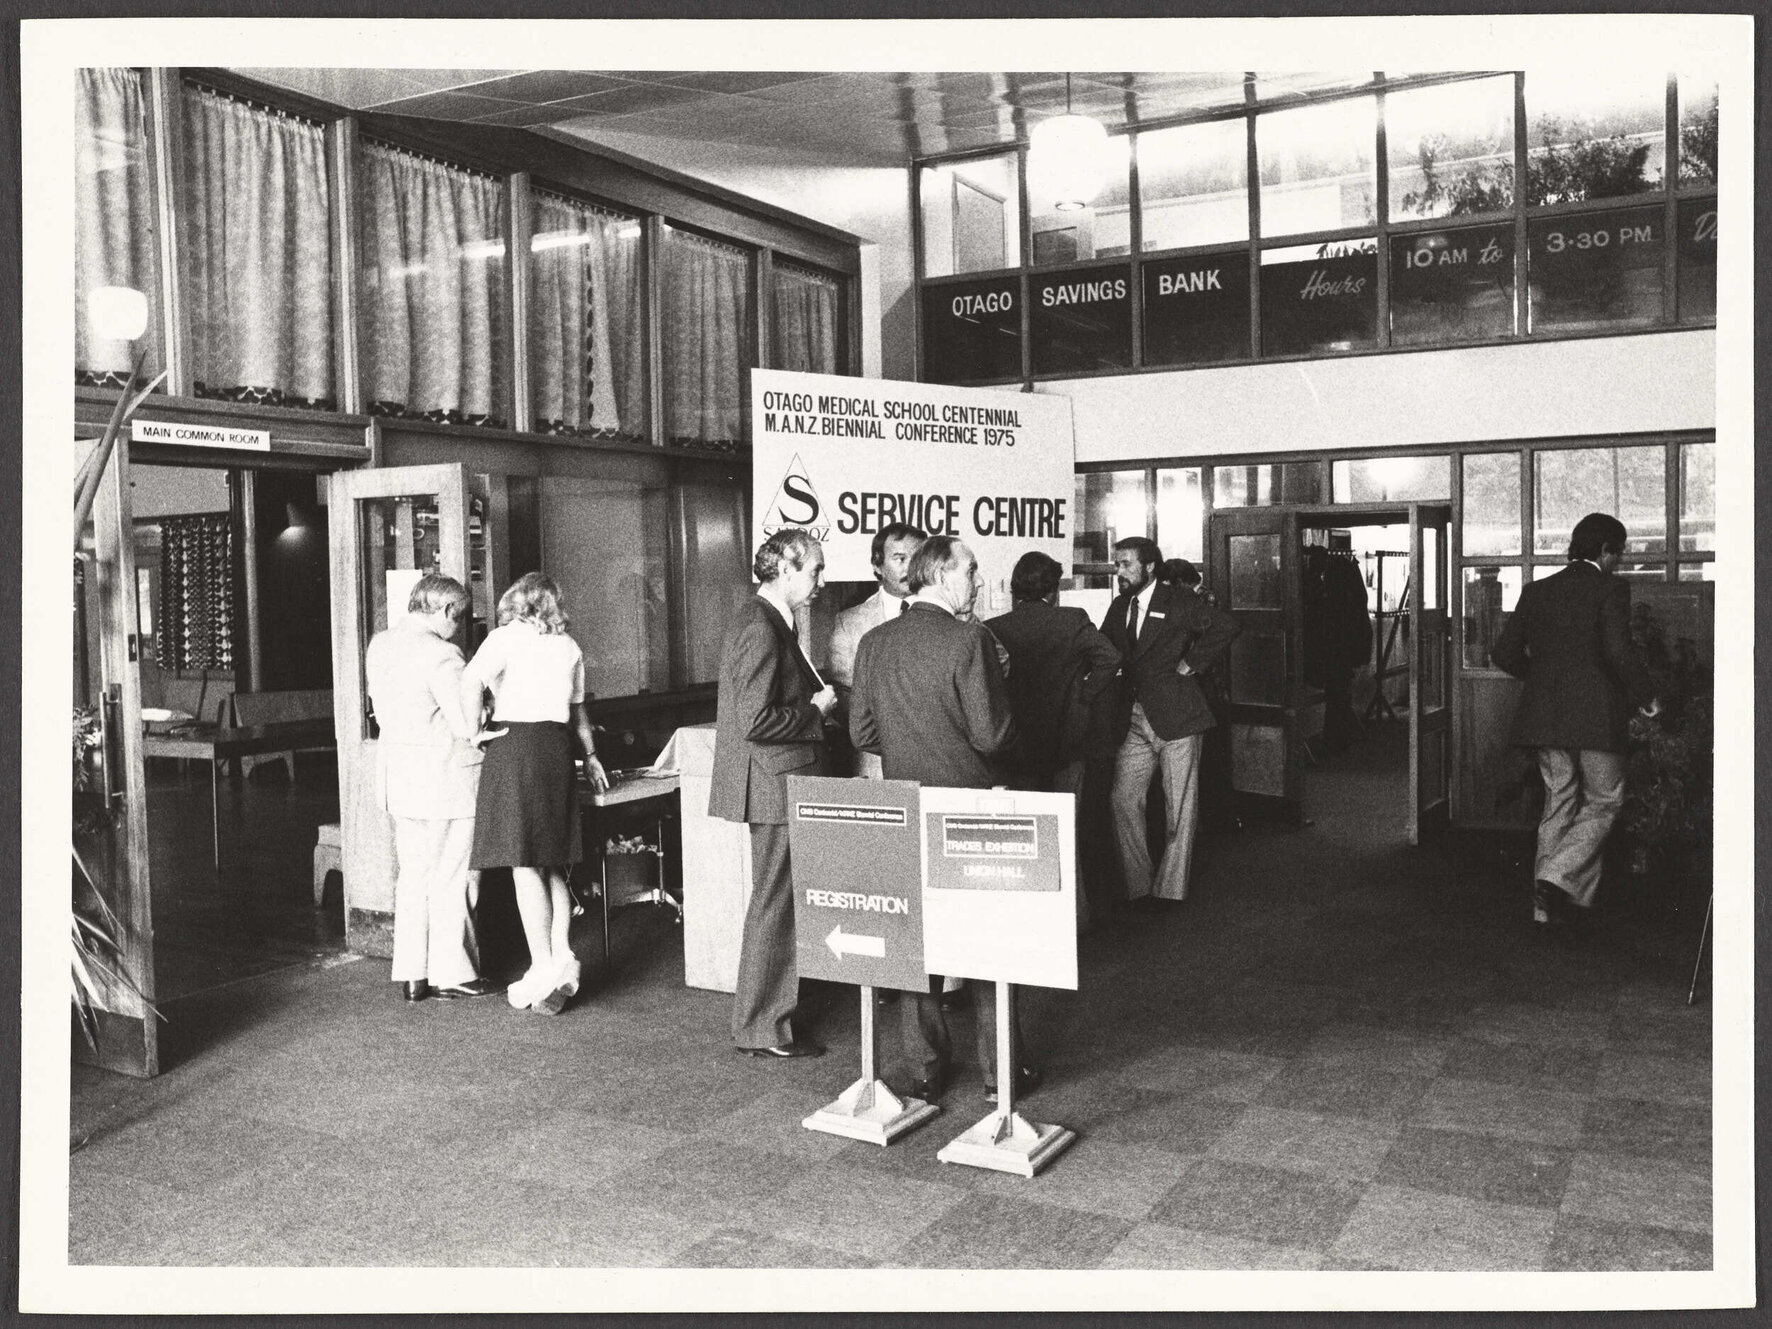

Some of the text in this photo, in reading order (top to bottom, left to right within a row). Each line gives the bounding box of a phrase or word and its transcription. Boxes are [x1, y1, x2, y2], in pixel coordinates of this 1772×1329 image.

[1300, 270, 1367, 300] Hours
[1406, 248, 1434, 270] 10
[1438, 247, 1468, 266] AM
[1478, 238, 1504, 265] to
[1619, 225, 1652, 245] PM
[952, 269, 1222, 317] OTAGO SAVINGS BANK
[763, 390, 1022, 428] OTAGO MEDICAL SCHOOL CENTENNIAL
[143, 426, 260, 445] MAIN COMMON ROOM
[895, 422, 978, 445] CONFERENCE
[983, 428, 1015, 447] 1975
[778, 474, 820, 525] S
[837, 491, 1067, 539] SERVICE CENTRE
[806, 889, 909, 915] REGISTRATION
